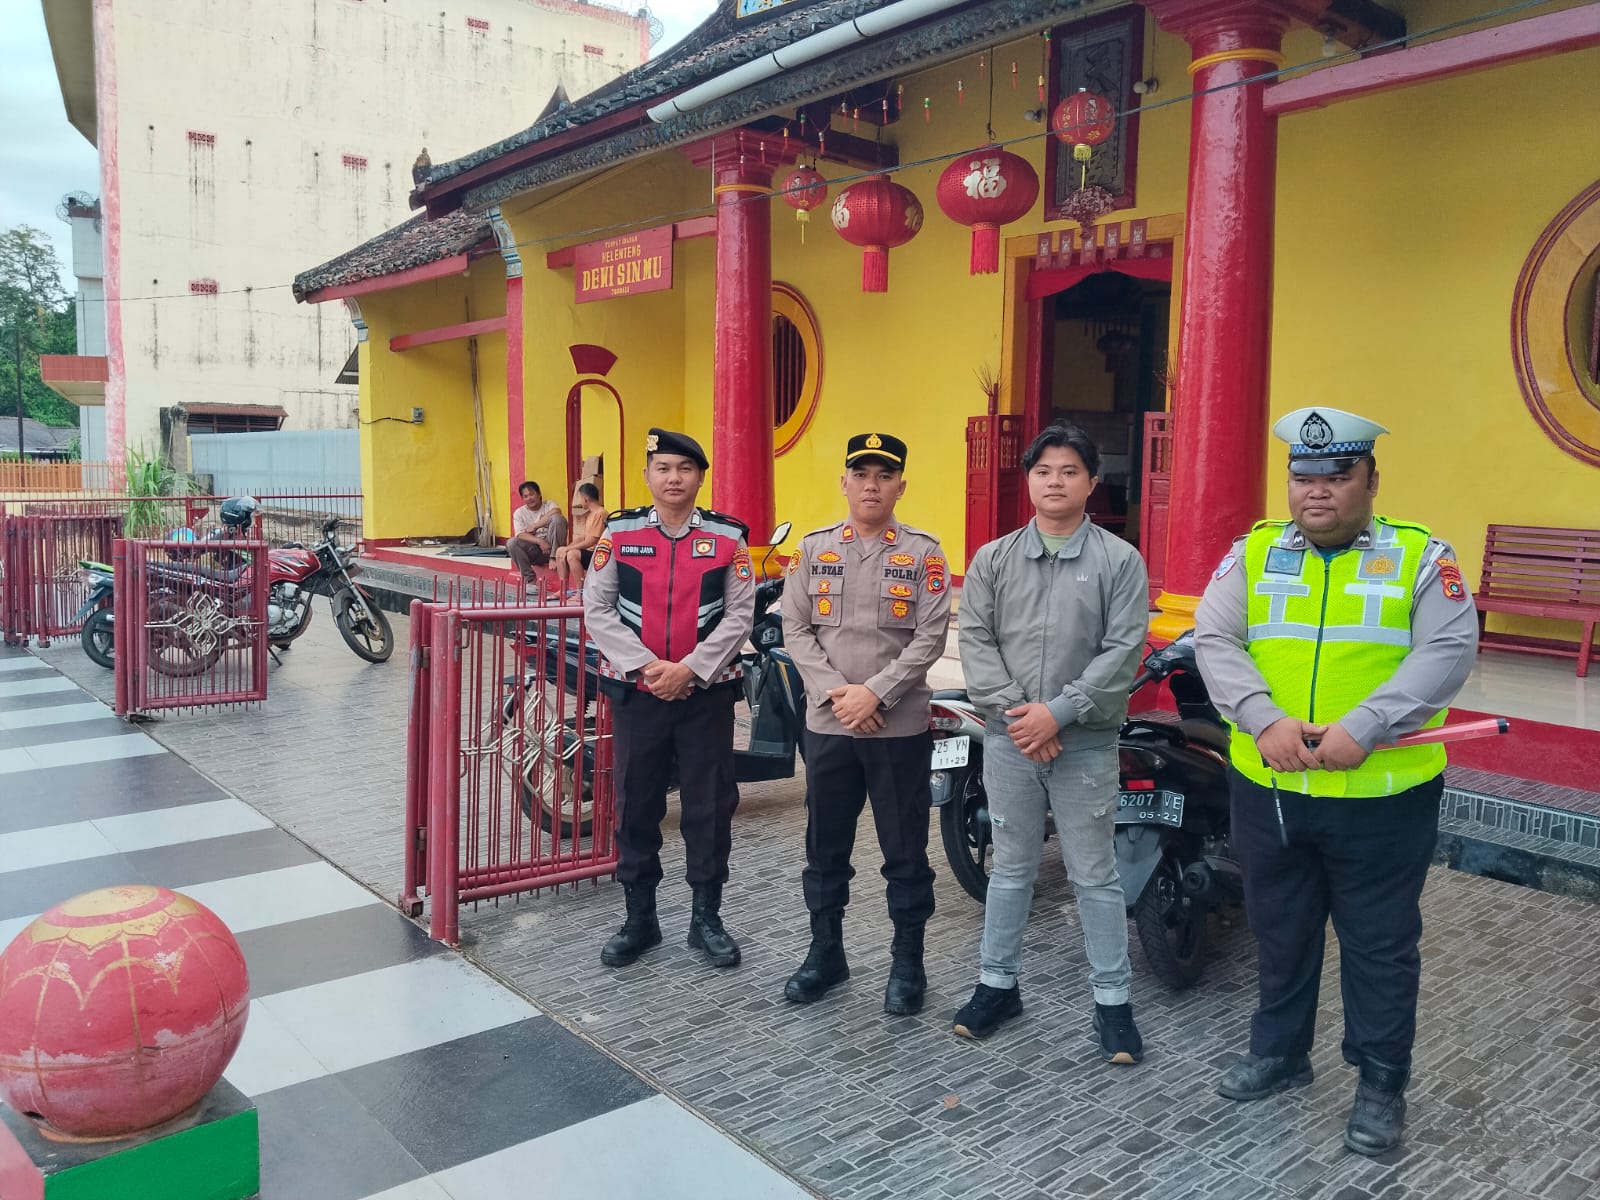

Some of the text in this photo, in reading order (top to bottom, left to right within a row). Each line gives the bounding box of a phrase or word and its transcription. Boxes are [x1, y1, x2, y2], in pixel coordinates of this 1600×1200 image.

[963, 157, 1008, 200] 福
[582, 265, 614, 291] DEWI
[621, 545, 654, 554] ROBIN JAYA
[884, 568, 918, 581] POLRI
[1120, 793, 1182, 810] 6207 VE
